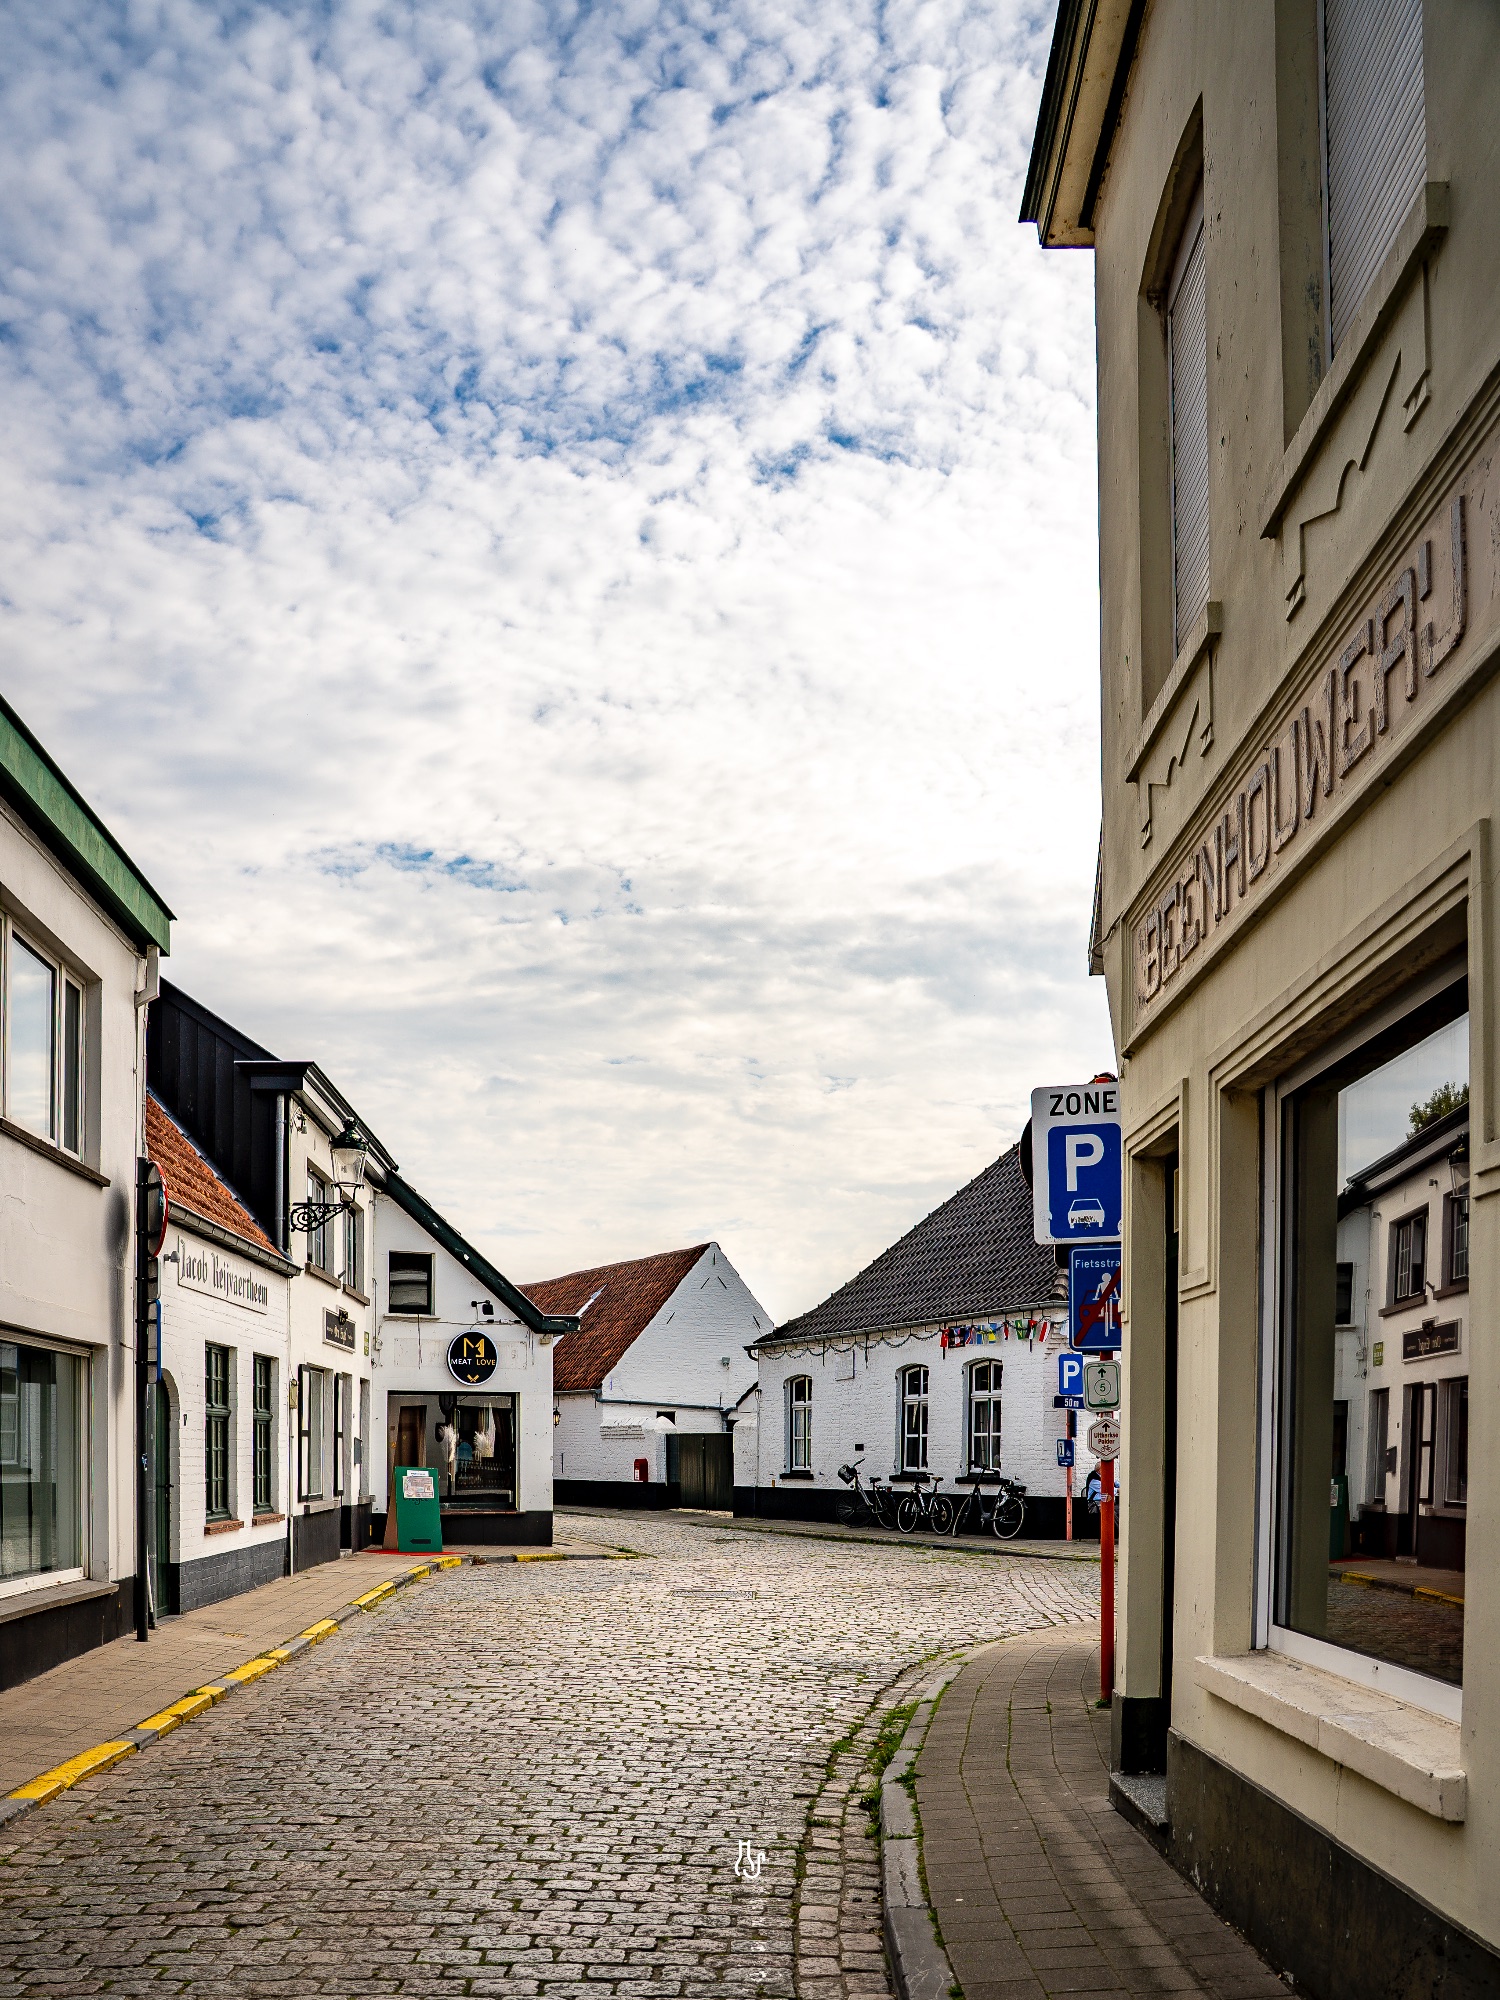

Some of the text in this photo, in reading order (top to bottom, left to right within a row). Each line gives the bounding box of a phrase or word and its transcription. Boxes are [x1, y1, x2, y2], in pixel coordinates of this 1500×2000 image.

[1049, 1090, 1117, 1117] ZONE
[1065, 1133, 1104, 1192] P
[180, 1238, 208, 1284] Jacob
[476, 1358, 496, 1366] LOVE
[1063, 1360, 1080, 1389] P
[1099, 1383, 1106, 1393] 5
[1064, 1398, 1073, 1408] 50
